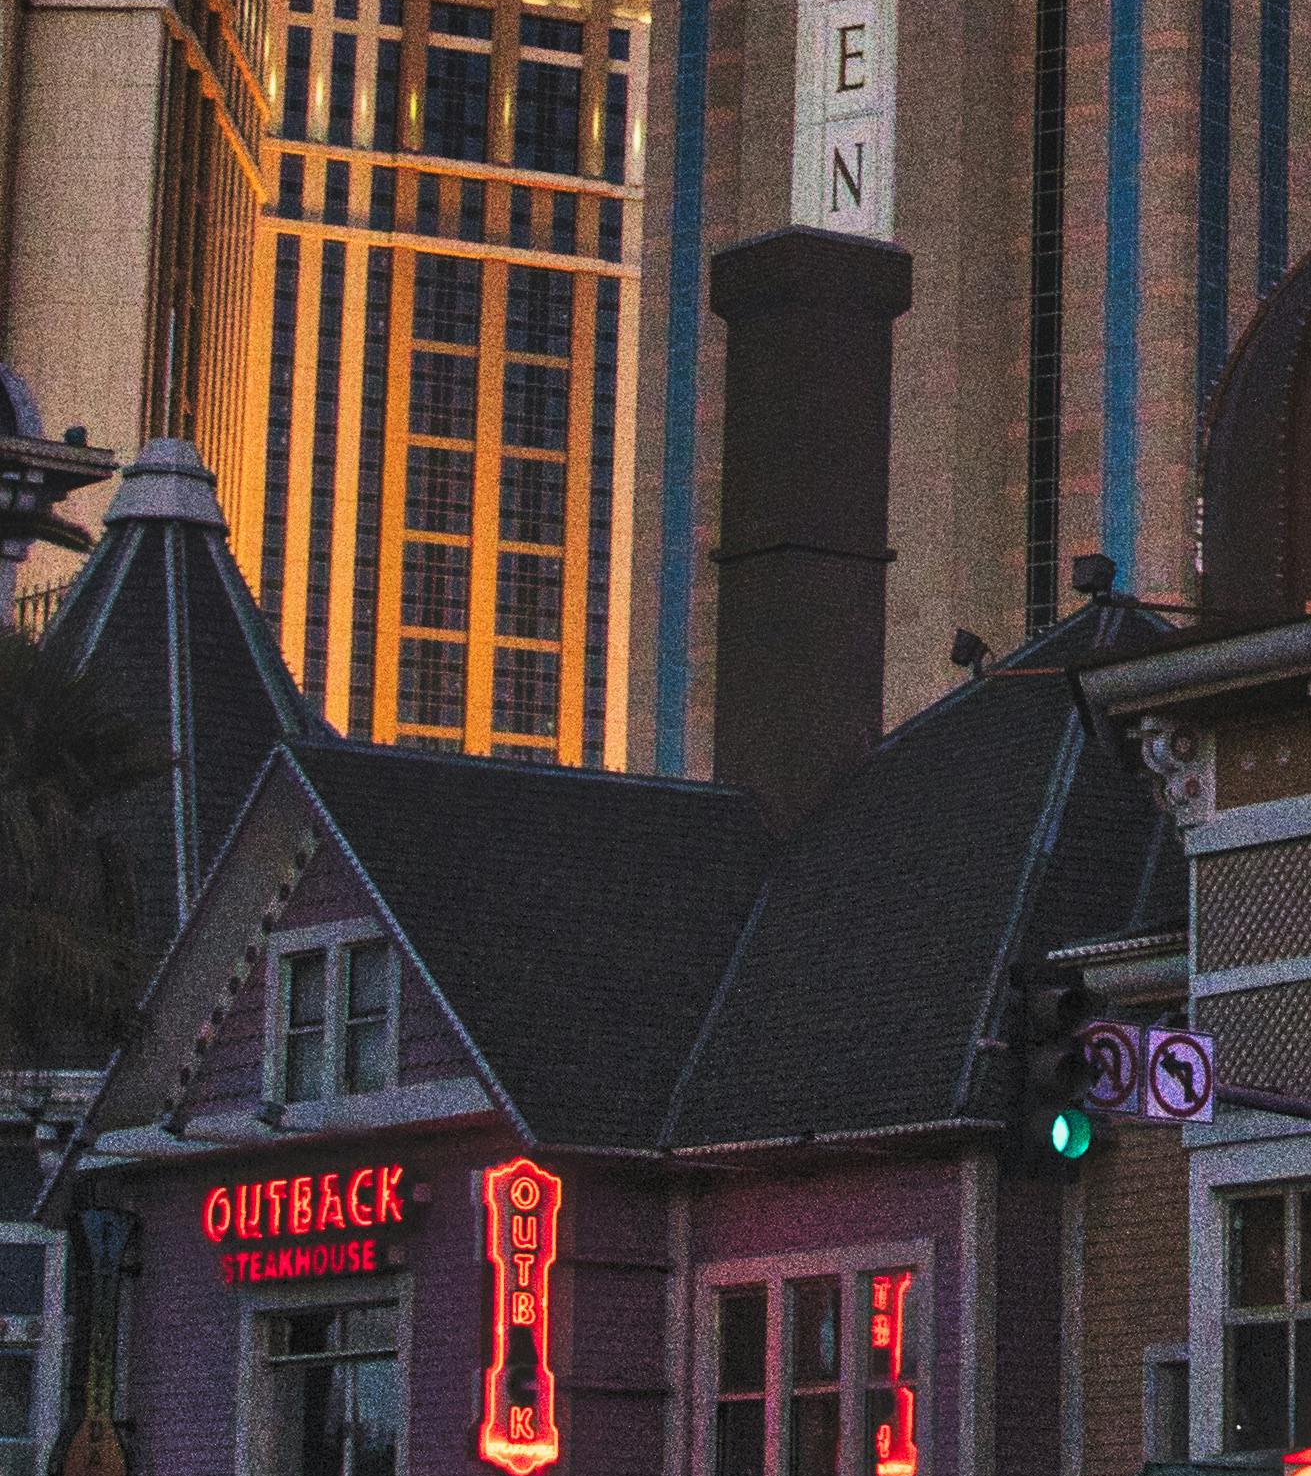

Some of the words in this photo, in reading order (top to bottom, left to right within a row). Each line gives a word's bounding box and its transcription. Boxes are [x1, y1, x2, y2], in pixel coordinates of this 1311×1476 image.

[203, 1165, 404, 1242] OUTBACK
[222, 1238, 377, 1285] STEAKHOUSE
[510, 1176, 541, 1441] OUTBK
